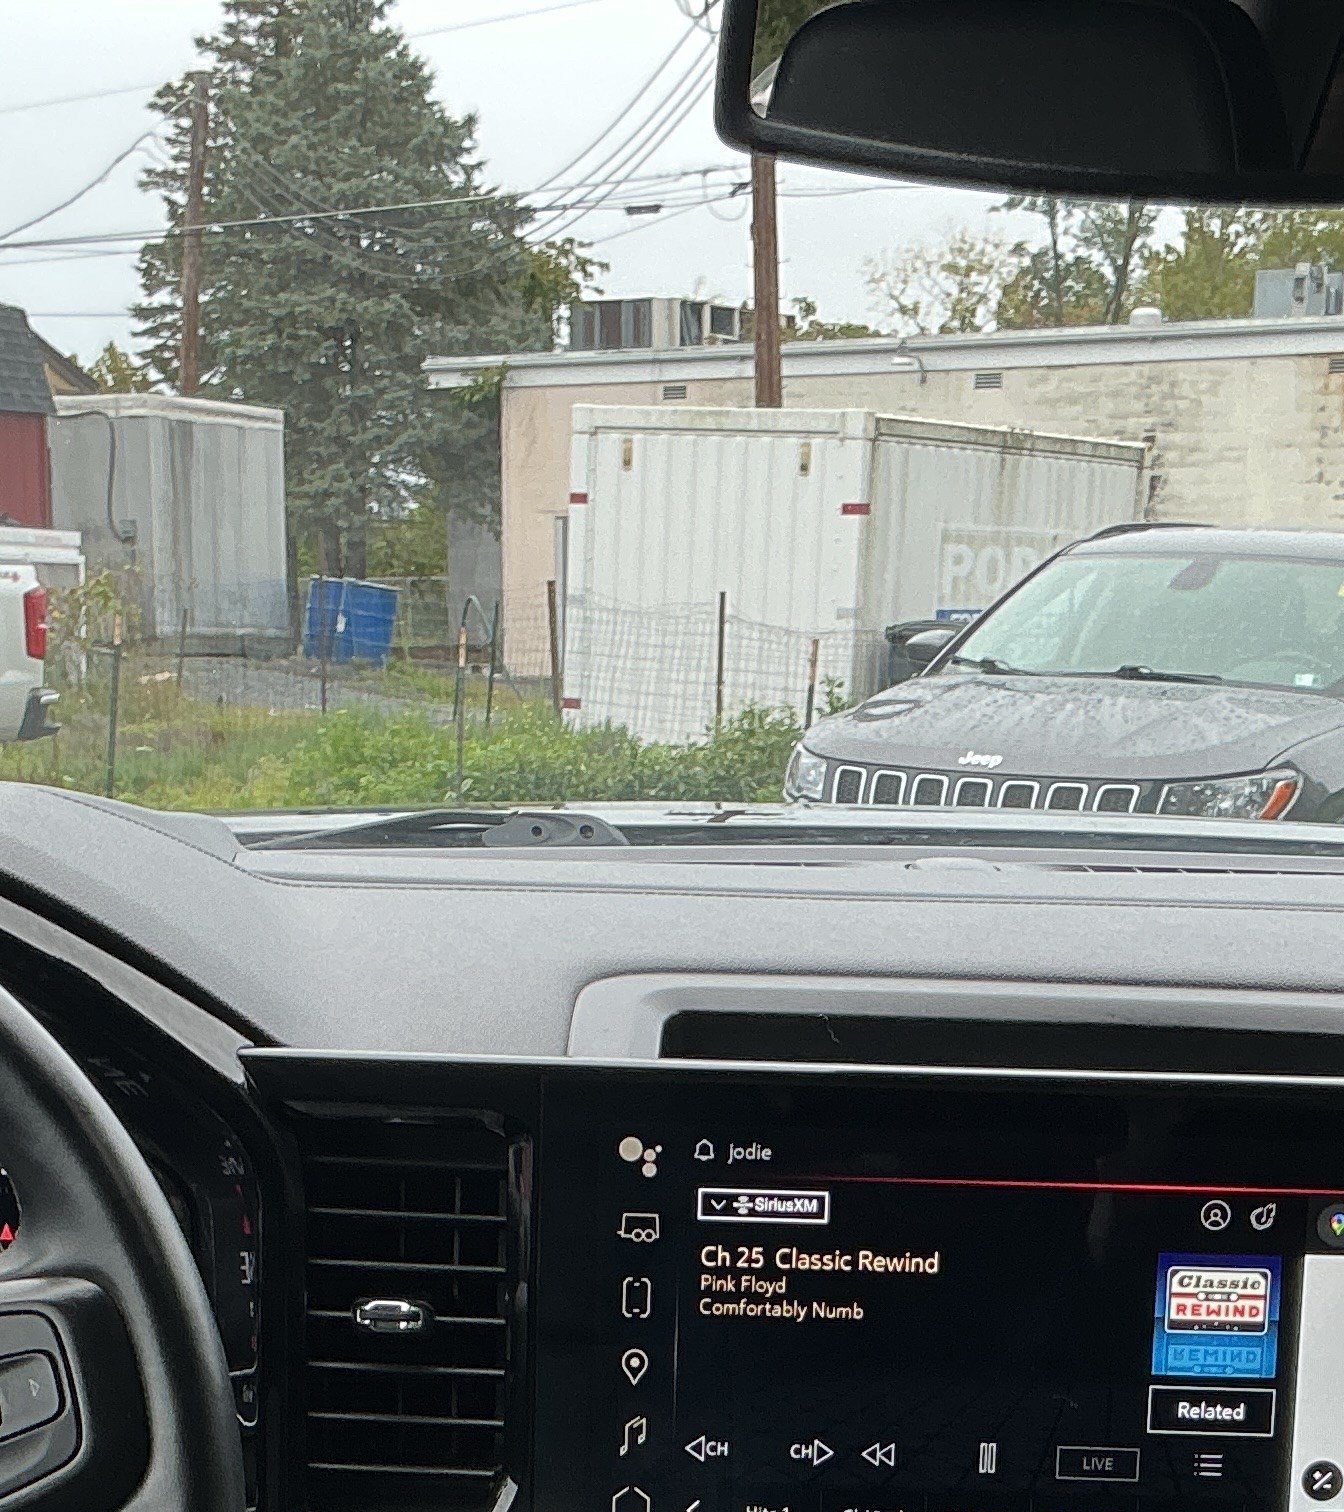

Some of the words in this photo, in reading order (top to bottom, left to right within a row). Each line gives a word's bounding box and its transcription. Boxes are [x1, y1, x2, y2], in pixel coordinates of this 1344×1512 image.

[958, 751, 1003, 768] Jeep
[755, 1197, 818, 1213] SiriusXM
[701, 1246, 731, 1268] Ch
[737, 1247, 764, 1268] 25
[775, 1249, 851, 1271] Classic
[859, 1251, 939, 1273] Rewind
[701, 1276, 735, 1293] Pink
[741, 1276, 786, 1297] Floyd
[1178, 1275, 1261, 1290] Classic
[700, 1300, 806, 1322] Comfortably
[812, 1302, 864, 1320] Numb
[1176, 1304, 1260, 1318] REWIND
[1178, 1402, 1245, 1421] Related
[707, 1441, 728, 1457] CH
[790, 1444, 812, 1459] CH
[1082, 1457, 1114, 1470] LIVE
